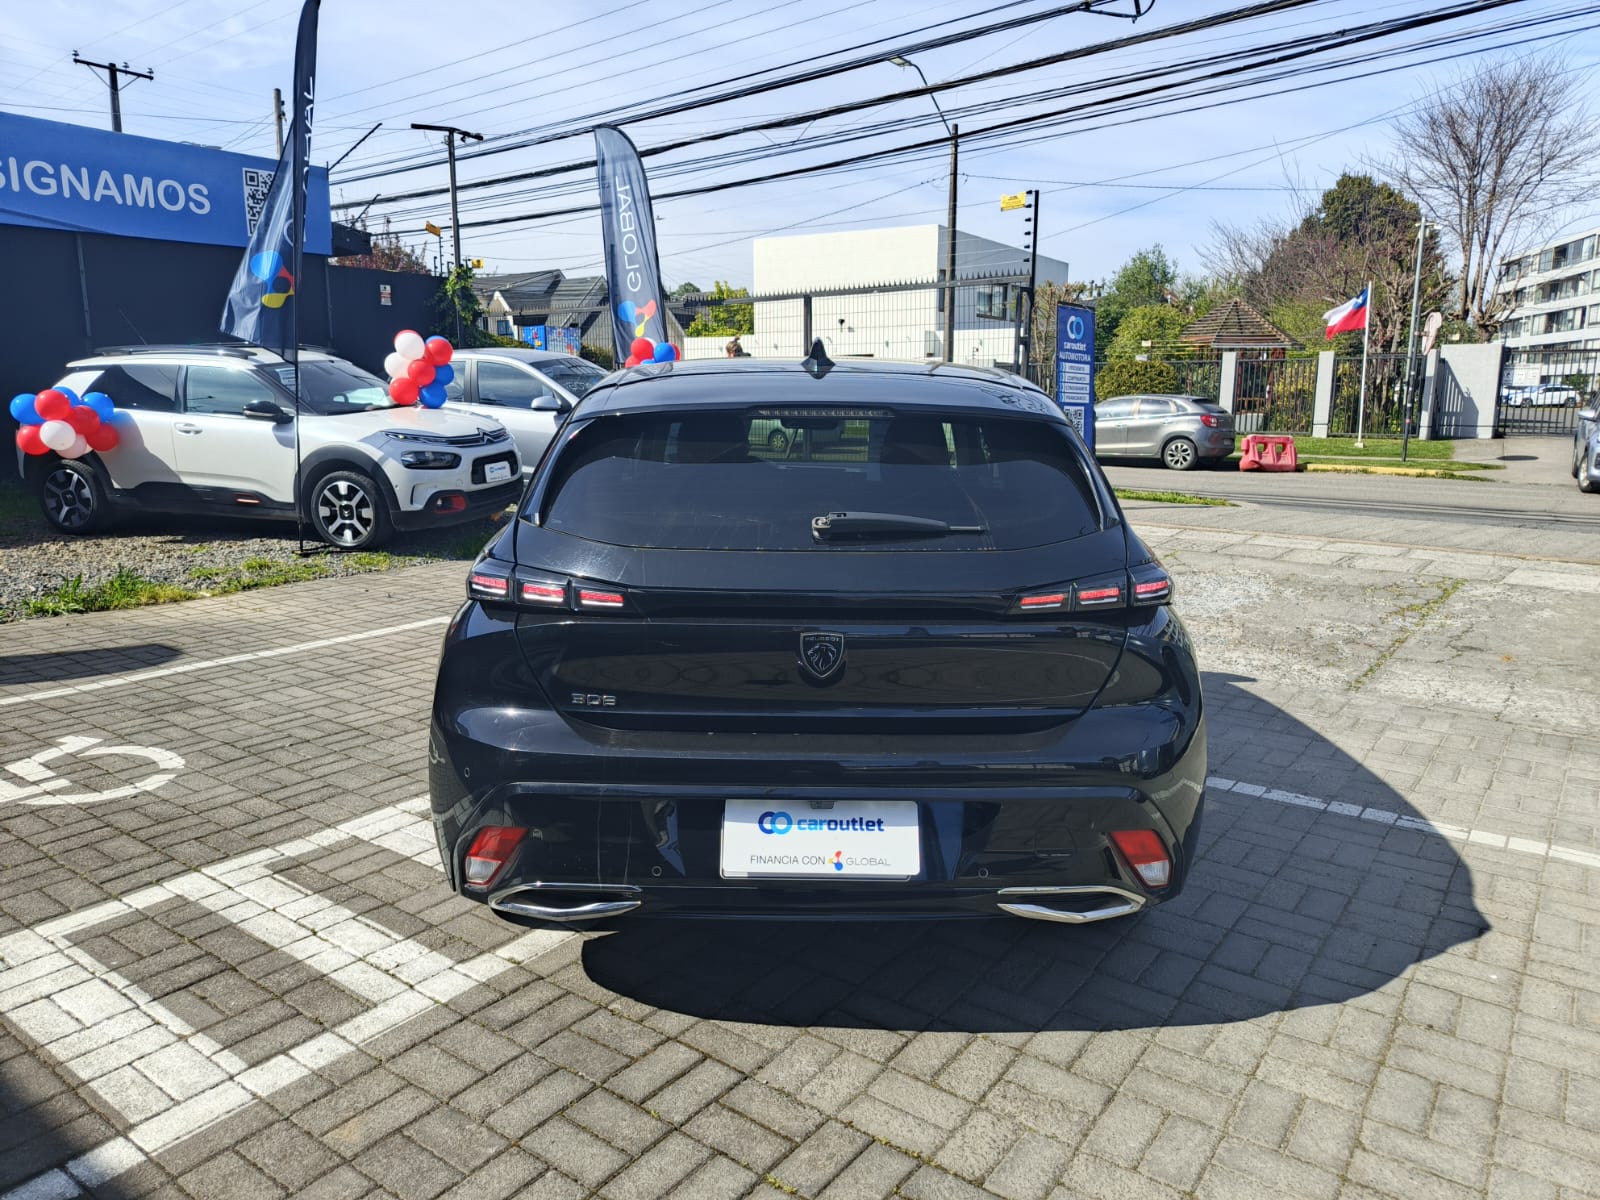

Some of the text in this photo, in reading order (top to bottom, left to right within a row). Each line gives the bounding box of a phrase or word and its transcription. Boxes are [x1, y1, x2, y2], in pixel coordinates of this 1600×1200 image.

[0, 157, 211, 215] IGNAMOS
[797, 816, 885, 832] caroutlet
[750, 855, 891, 867] FINANCIA CON GLOBAL
